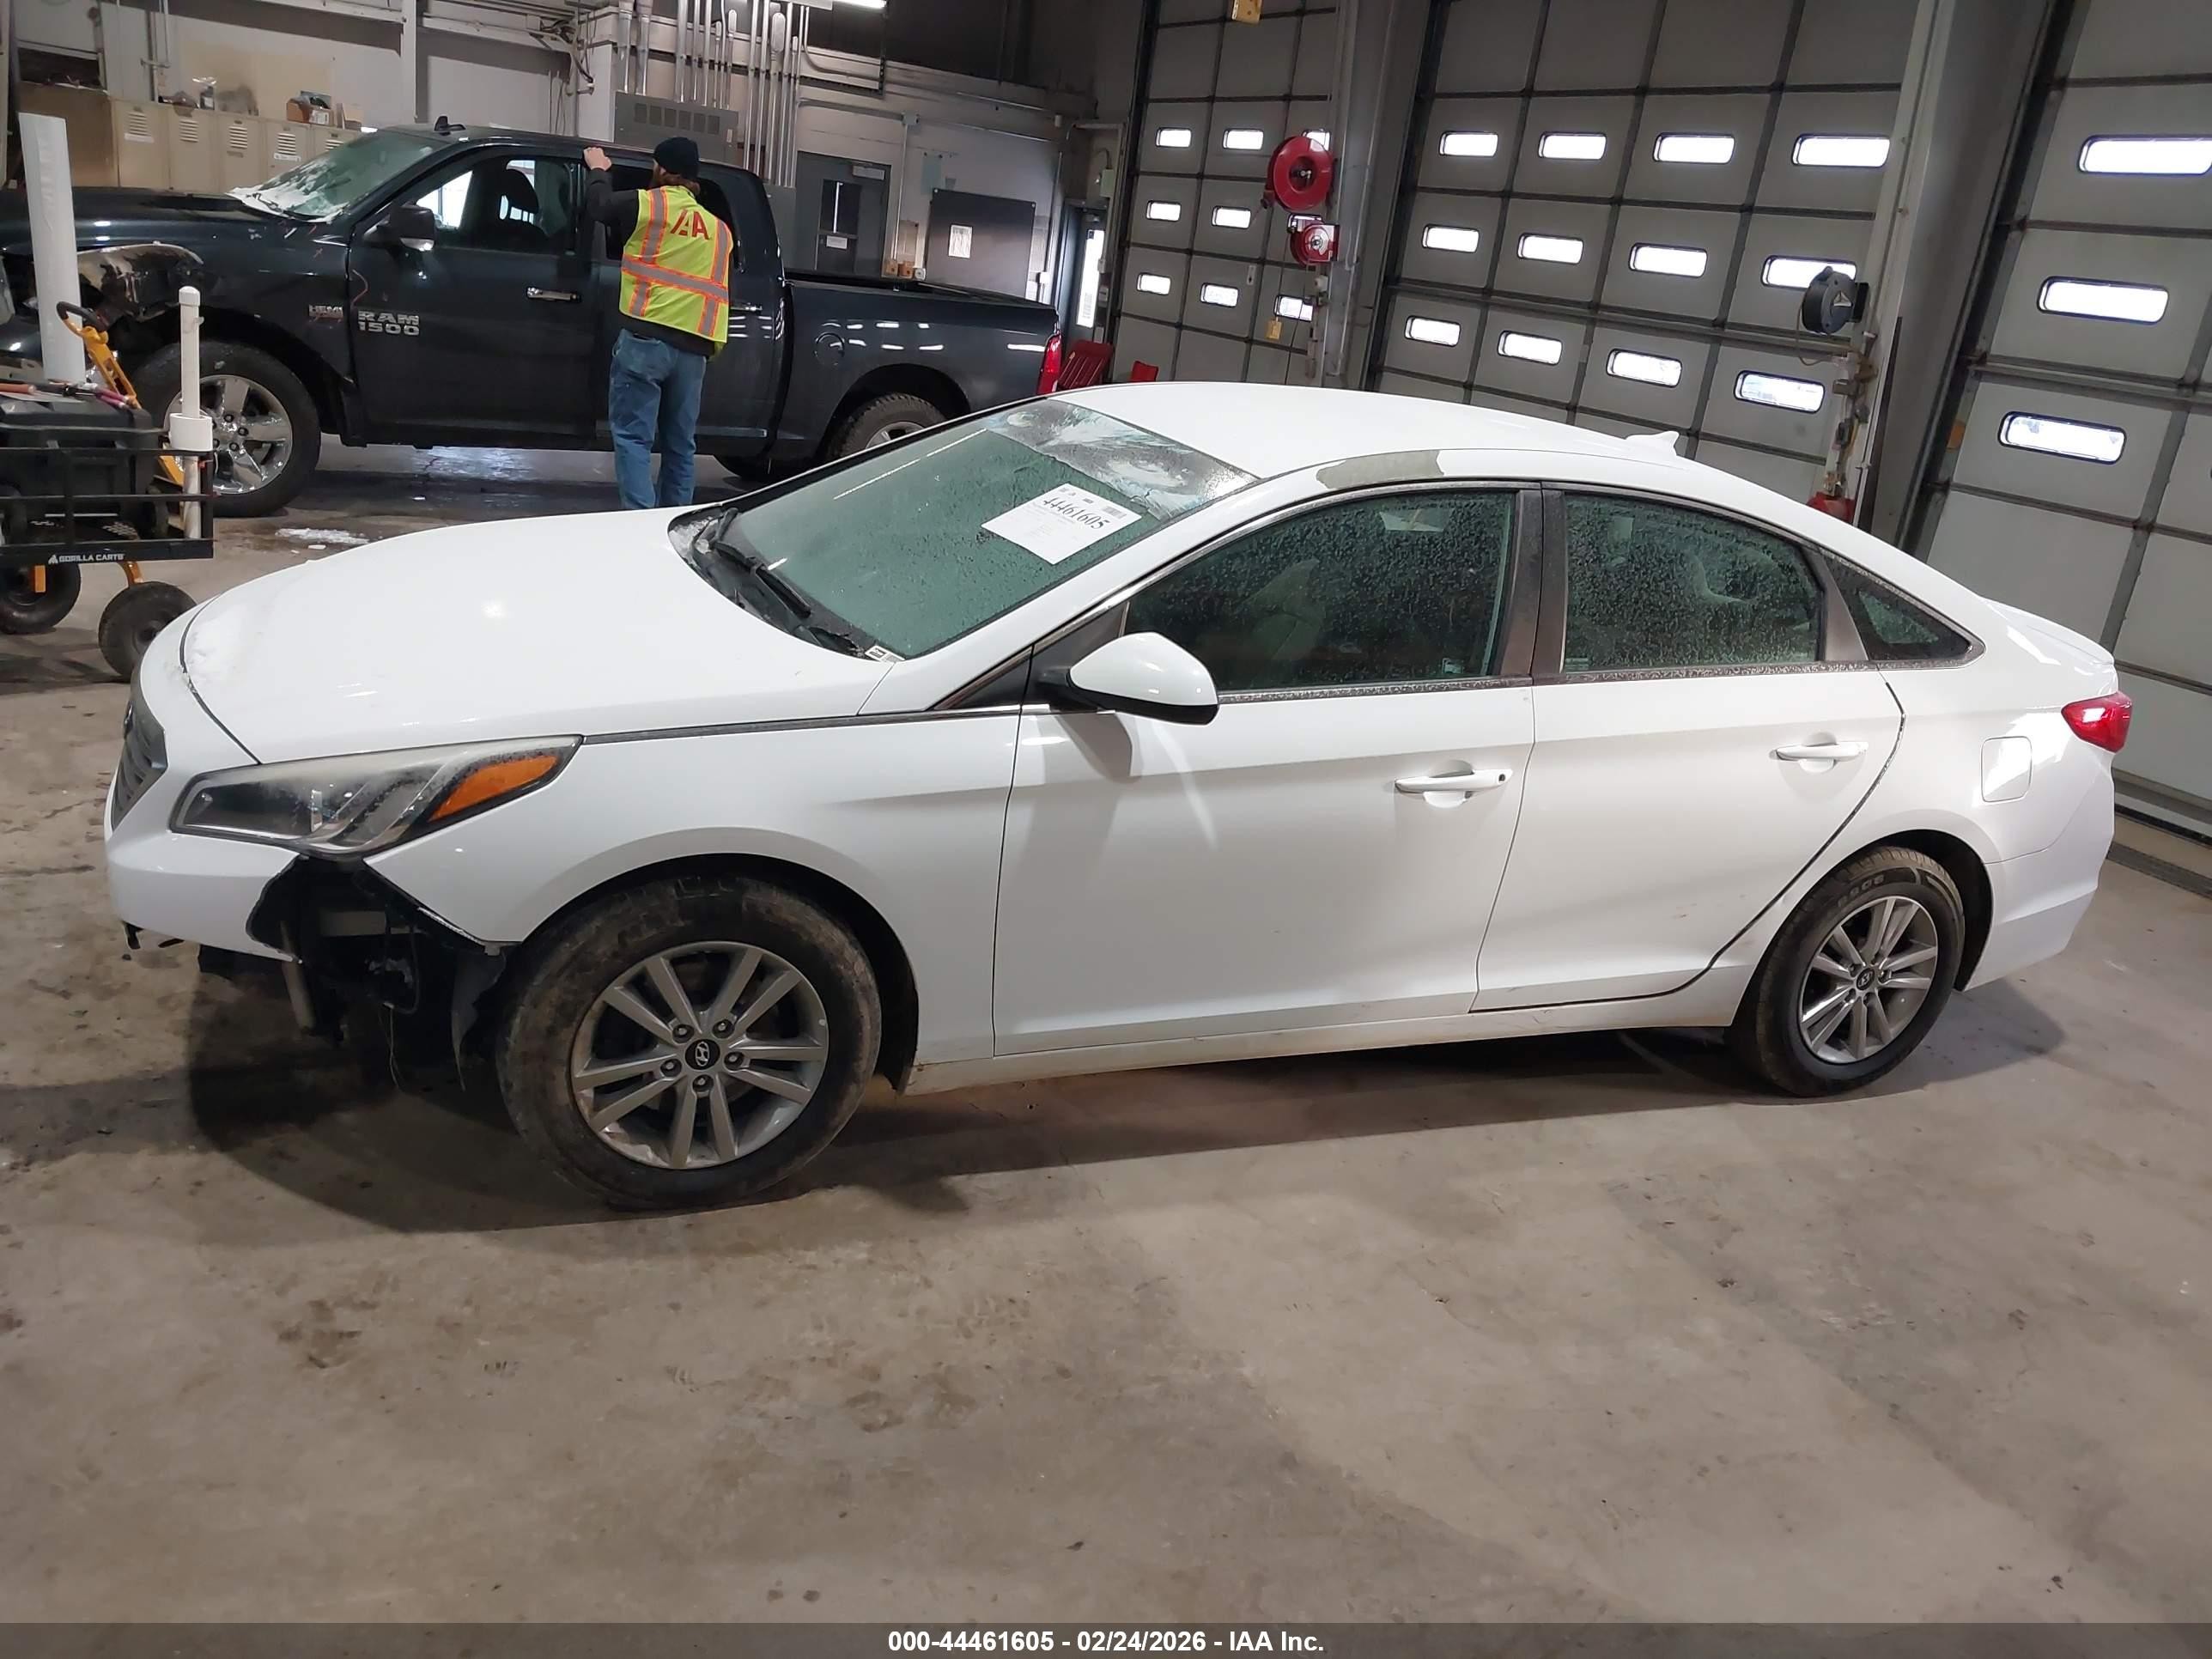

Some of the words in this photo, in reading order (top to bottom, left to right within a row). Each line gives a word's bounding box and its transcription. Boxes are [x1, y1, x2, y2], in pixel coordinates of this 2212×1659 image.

[358, 311, 419, 325] RAM
[358, 321, 419, 335] 1500
[1044, 497, 1110, 529] 44461605
